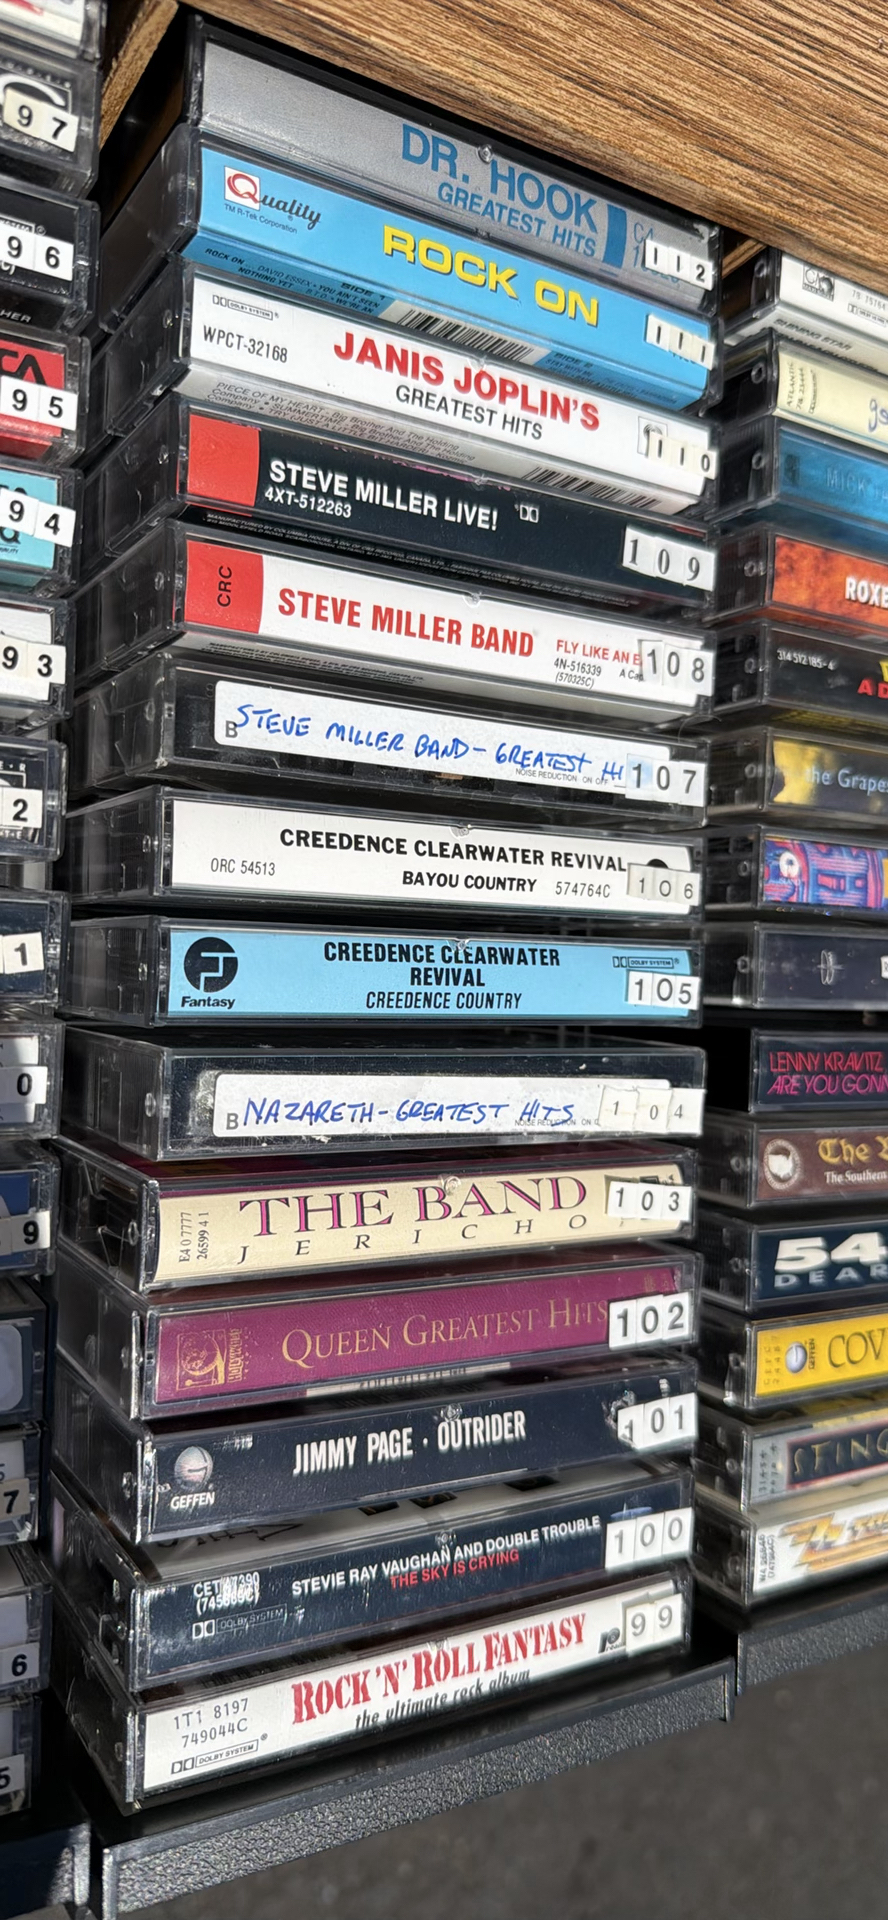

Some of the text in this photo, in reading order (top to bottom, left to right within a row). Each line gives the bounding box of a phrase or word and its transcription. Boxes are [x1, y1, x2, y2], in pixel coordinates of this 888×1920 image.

[18, 105, 67, 140] 97
[402, 123, 598, 234] DR. HOOK
[227, 173, 321, 230] Quality
[237, 207, 298, 234] R-Tek Corporation
[438, 182, 597, 258] GREATEST HITS
[7, 236, 60, 269] 96
[204, 247, 245, 265] ROCK ON
[238, 266, 294, 289] NOTHING YET
[340, 282, 372, 297] SIDE
[384, 224, 598, 327] ROCK ON
[203, 325, 288, 364] WPCT-32168
[334, 331, 445, 386] JANIS
[453, 366, 600, 431] JOPLIN'S
[12, 388, 64, 419] 95
[206, 393, 288, 418] Company TRY
[217, 381, 460, 451] PIECE OF MY HEART Big Brother And The Holding
[395, 384, 543, 440] GREATEST HITS
[211, 388, 476, 461] Company SUMMERTIME Big Brother And The Holding
[269, 459, 498, 531] STEVE MILLER LIVE!
[826, 467, 867, 498] MICK
[9, 500, 60, 536] 94
[264, 487, 352, 519] 4XT-512263
[628, 538, 701, 582] 109
[217, 565, 233, 608] CRC
[844, 576, 888, 609] ROXE
[278, 588, 534, 657] STEVE MILLER BAND
[2, 646, 53, 677] 93
[553, 657, 602, 677] 4N-516339
[556, 639, 630, 664] FLY LIKE AN
[647, 647, 705, 683] 108
[776, 648, 808, 665] 314 512
[555, 672, 595, 690] (570325C)
[619, 668, 626, 678] A
[225, 721, 238, 738] B
[235, 703, 593, 774] STEVE MILLER BAND GREATEST
[515, 767, 609, 786] NOISE REDUCTION ON OFF
[632, 763, 697, 794] 107
[280, 828, 626, 872] CREEDENCE CLEARWATER REVIVAL
[211, 857, 276, 876] ORC 54513
[402, 870, 610, 898] BAYOU COUNTRY 574764C
[639, 877, 694, 900] 106
[324, 942, 560, 966] CREEDENCE CLEARWATER
[630, 959, 671, 967] DOLBY SYSTEM
[410, 967, 485, 987] REVIVAL
[634, 978, 692, 1004] 105
[181, 996, 236, 1010] Fantasy
[366, 991, 522, 1009] CREEDENCE COUNTRY
[768, 1051, 883, 1072] LENNY KRAVITZ
[767, 1074, 888, 1095] ARE YOU GONN
[225, 1113, 239, 1130] B
[243, 1097, 574, 1127] NAZARETH GREATEST HITS
[515, 1119, 536, 1127] NOISE
[582, 1118, 592, 1126] ON
[612, 1100, 684, 1121] 104
[817, 1138, 872, 1165] The
[824, 1171, 843, 1184] The
[239, 1176, 587, 1237] THE BAND
[615, 1187, 680, 1213] 103
[180, 1211, 192, 1237] 7777
[196, 1229, 209, 1261] 26599
[617, 1301, 684, 1337] 102
[828, 1327, 888, 1368] COV
[624, 1404, 684, 1442] 101
[293, 1410, 526, 1476] JIMMY PAGE OUTRIDER
[170, 1491, 215, 1510] GEFFEN
[615, 1517, 683, 1554] 100
[292, 1515, 600, 1596] STEVIE RAY VAUGHAN AND DOUBLE TROUBLE
[390, 1548, 519, 1589] THE SKY IS CRYING
[630, 1604, 673, 1637] 99
[291, 1612, 586, 1725] ROCK ROLL FANTASY
[173, 1698, 249, 1730] 1T1 8197
[355, 1668, 531, 1729] the ultimate rock album
[181, 1718, 249, 1749] 749044C
[198, 1743, 254, 1765] DOLBY SYSTEM
